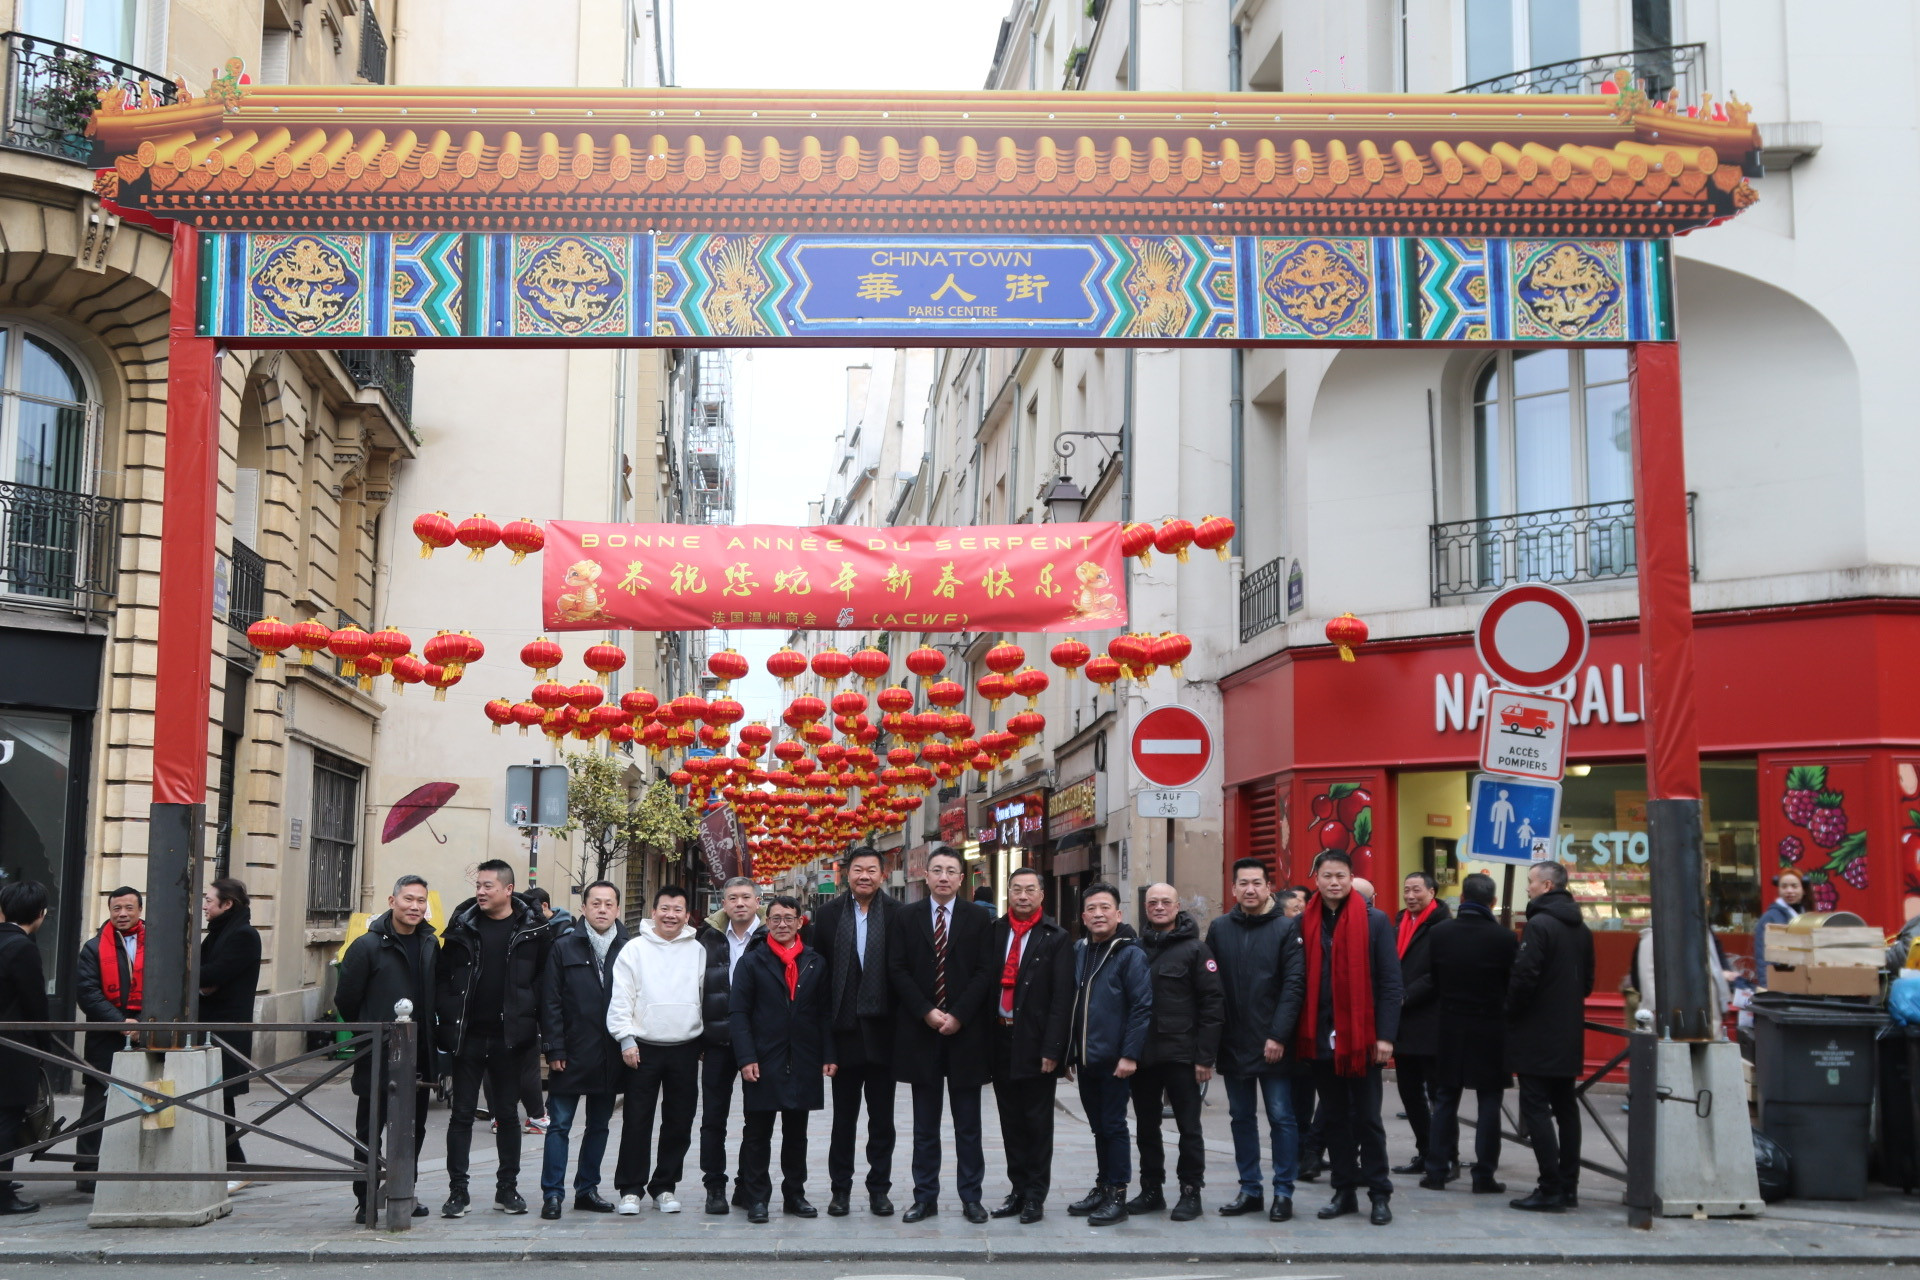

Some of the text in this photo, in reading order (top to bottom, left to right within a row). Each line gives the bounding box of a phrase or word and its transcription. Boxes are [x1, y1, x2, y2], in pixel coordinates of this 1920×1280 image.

[871, 251, 1032, 267] CHINATOWN
[856, 272, 1050, 303] 華人街
[908, 306, 998, 317] PARIS CENTRE
[581, 533, 701, 549] BONNE
[726, 536, 844, 552] ANNÉE
[936, 536, 1094, 551] SERPENT
[617, 559, 1062, 602] 恭祝您蛇年新春快乐
[712, 611, 817, 625] 法国温州商会
[872, 613, 969, 626] (ACWF)
[1435, 663, 1646, 732] NARAL
[1508, 746, 1540, 759] ACCÈS
[1498, 756, 1548, 771] POMPIERS
[1156, 793, 1182, 801] SAUF
[701, 822, 726, 881] SKATESHOP
[1592, 831, 1650, 865] STO
